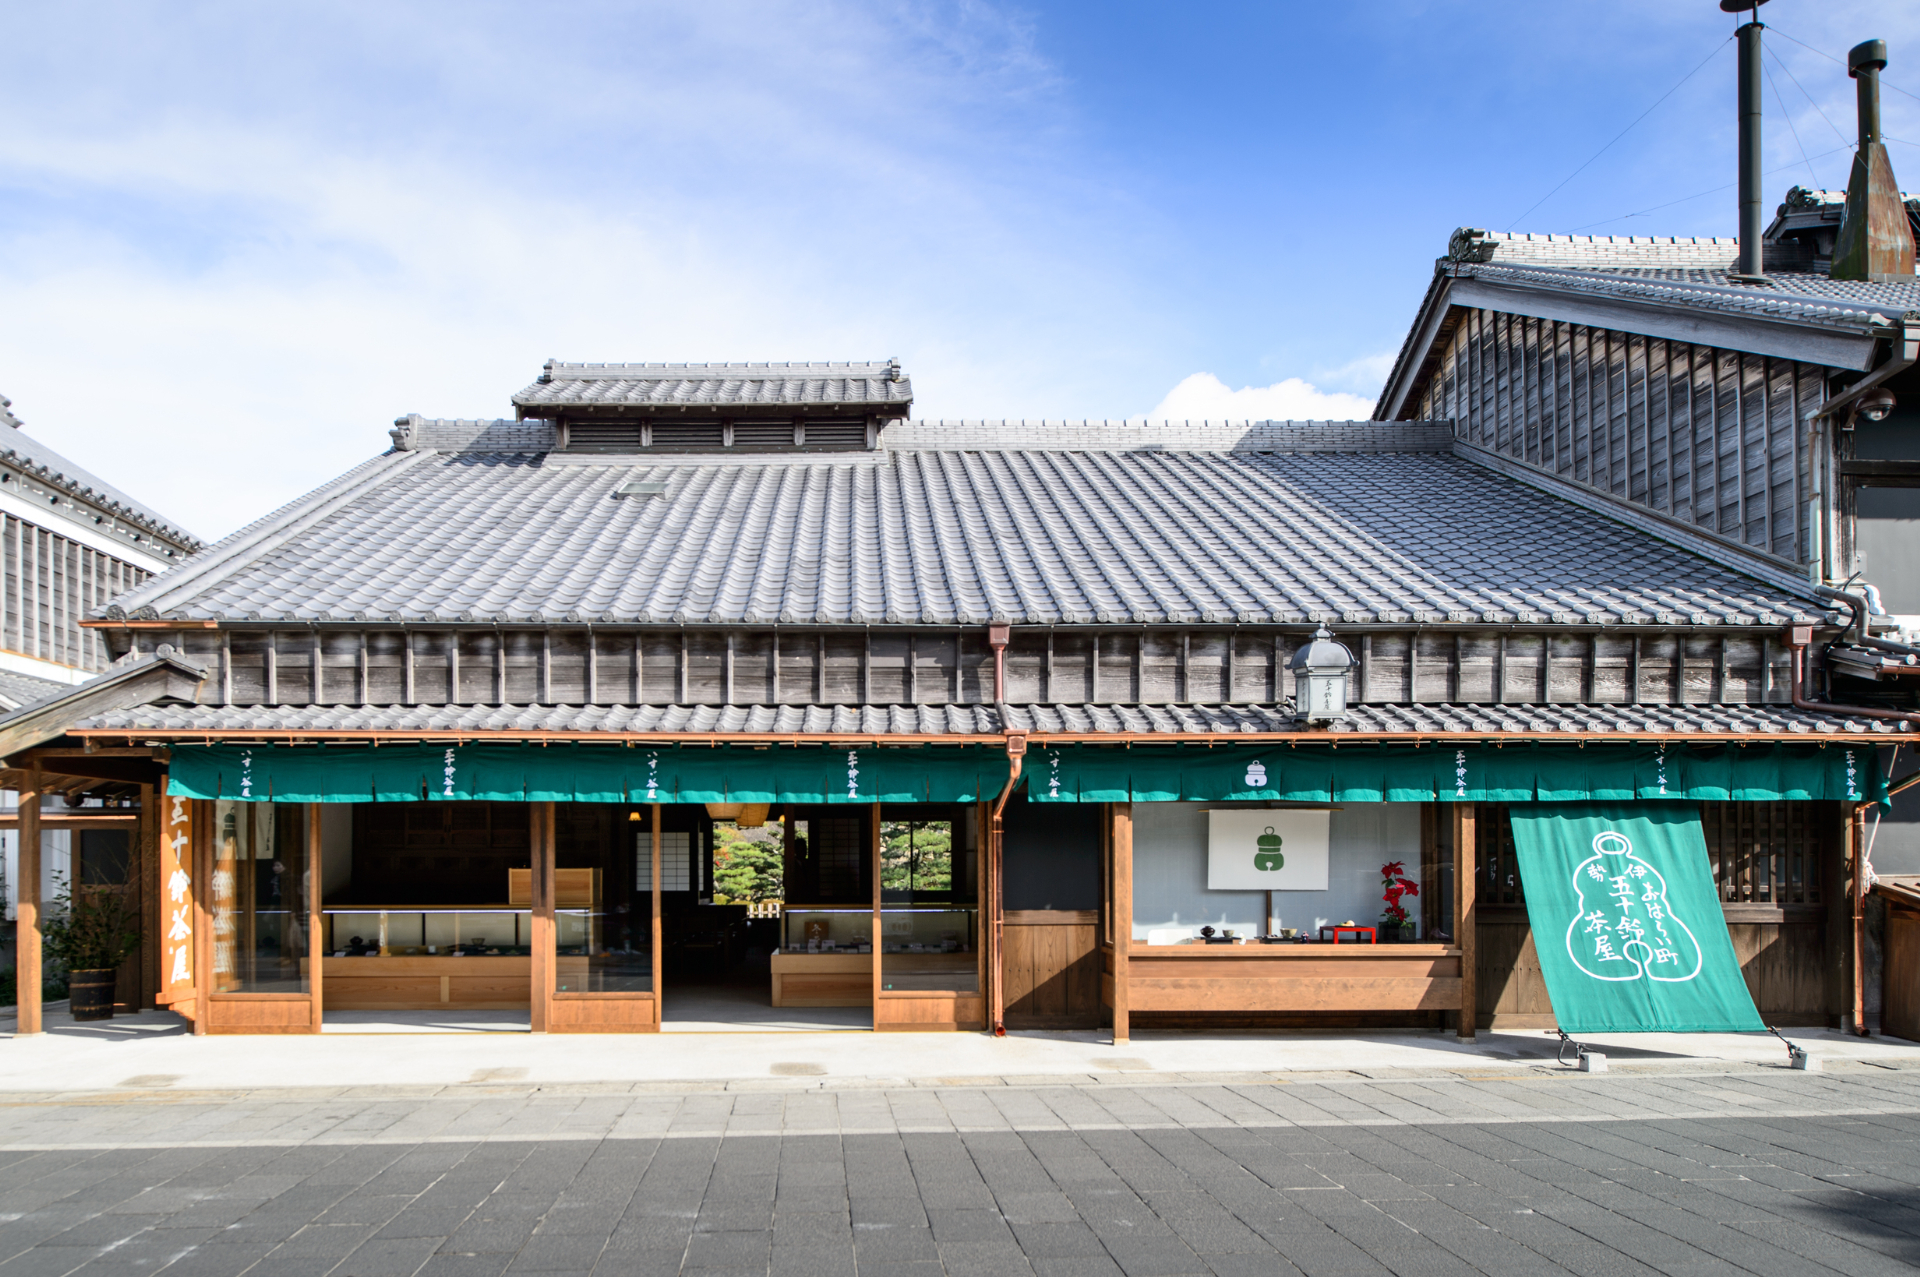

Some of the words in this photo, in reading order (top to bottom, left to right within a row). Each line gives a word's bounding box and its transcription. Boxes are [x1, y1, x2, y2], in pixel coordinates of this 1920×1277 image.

[167, 795, 192, 984] 五十鈴茶屋
[1641, 881, 1679, 966] おはらい町
